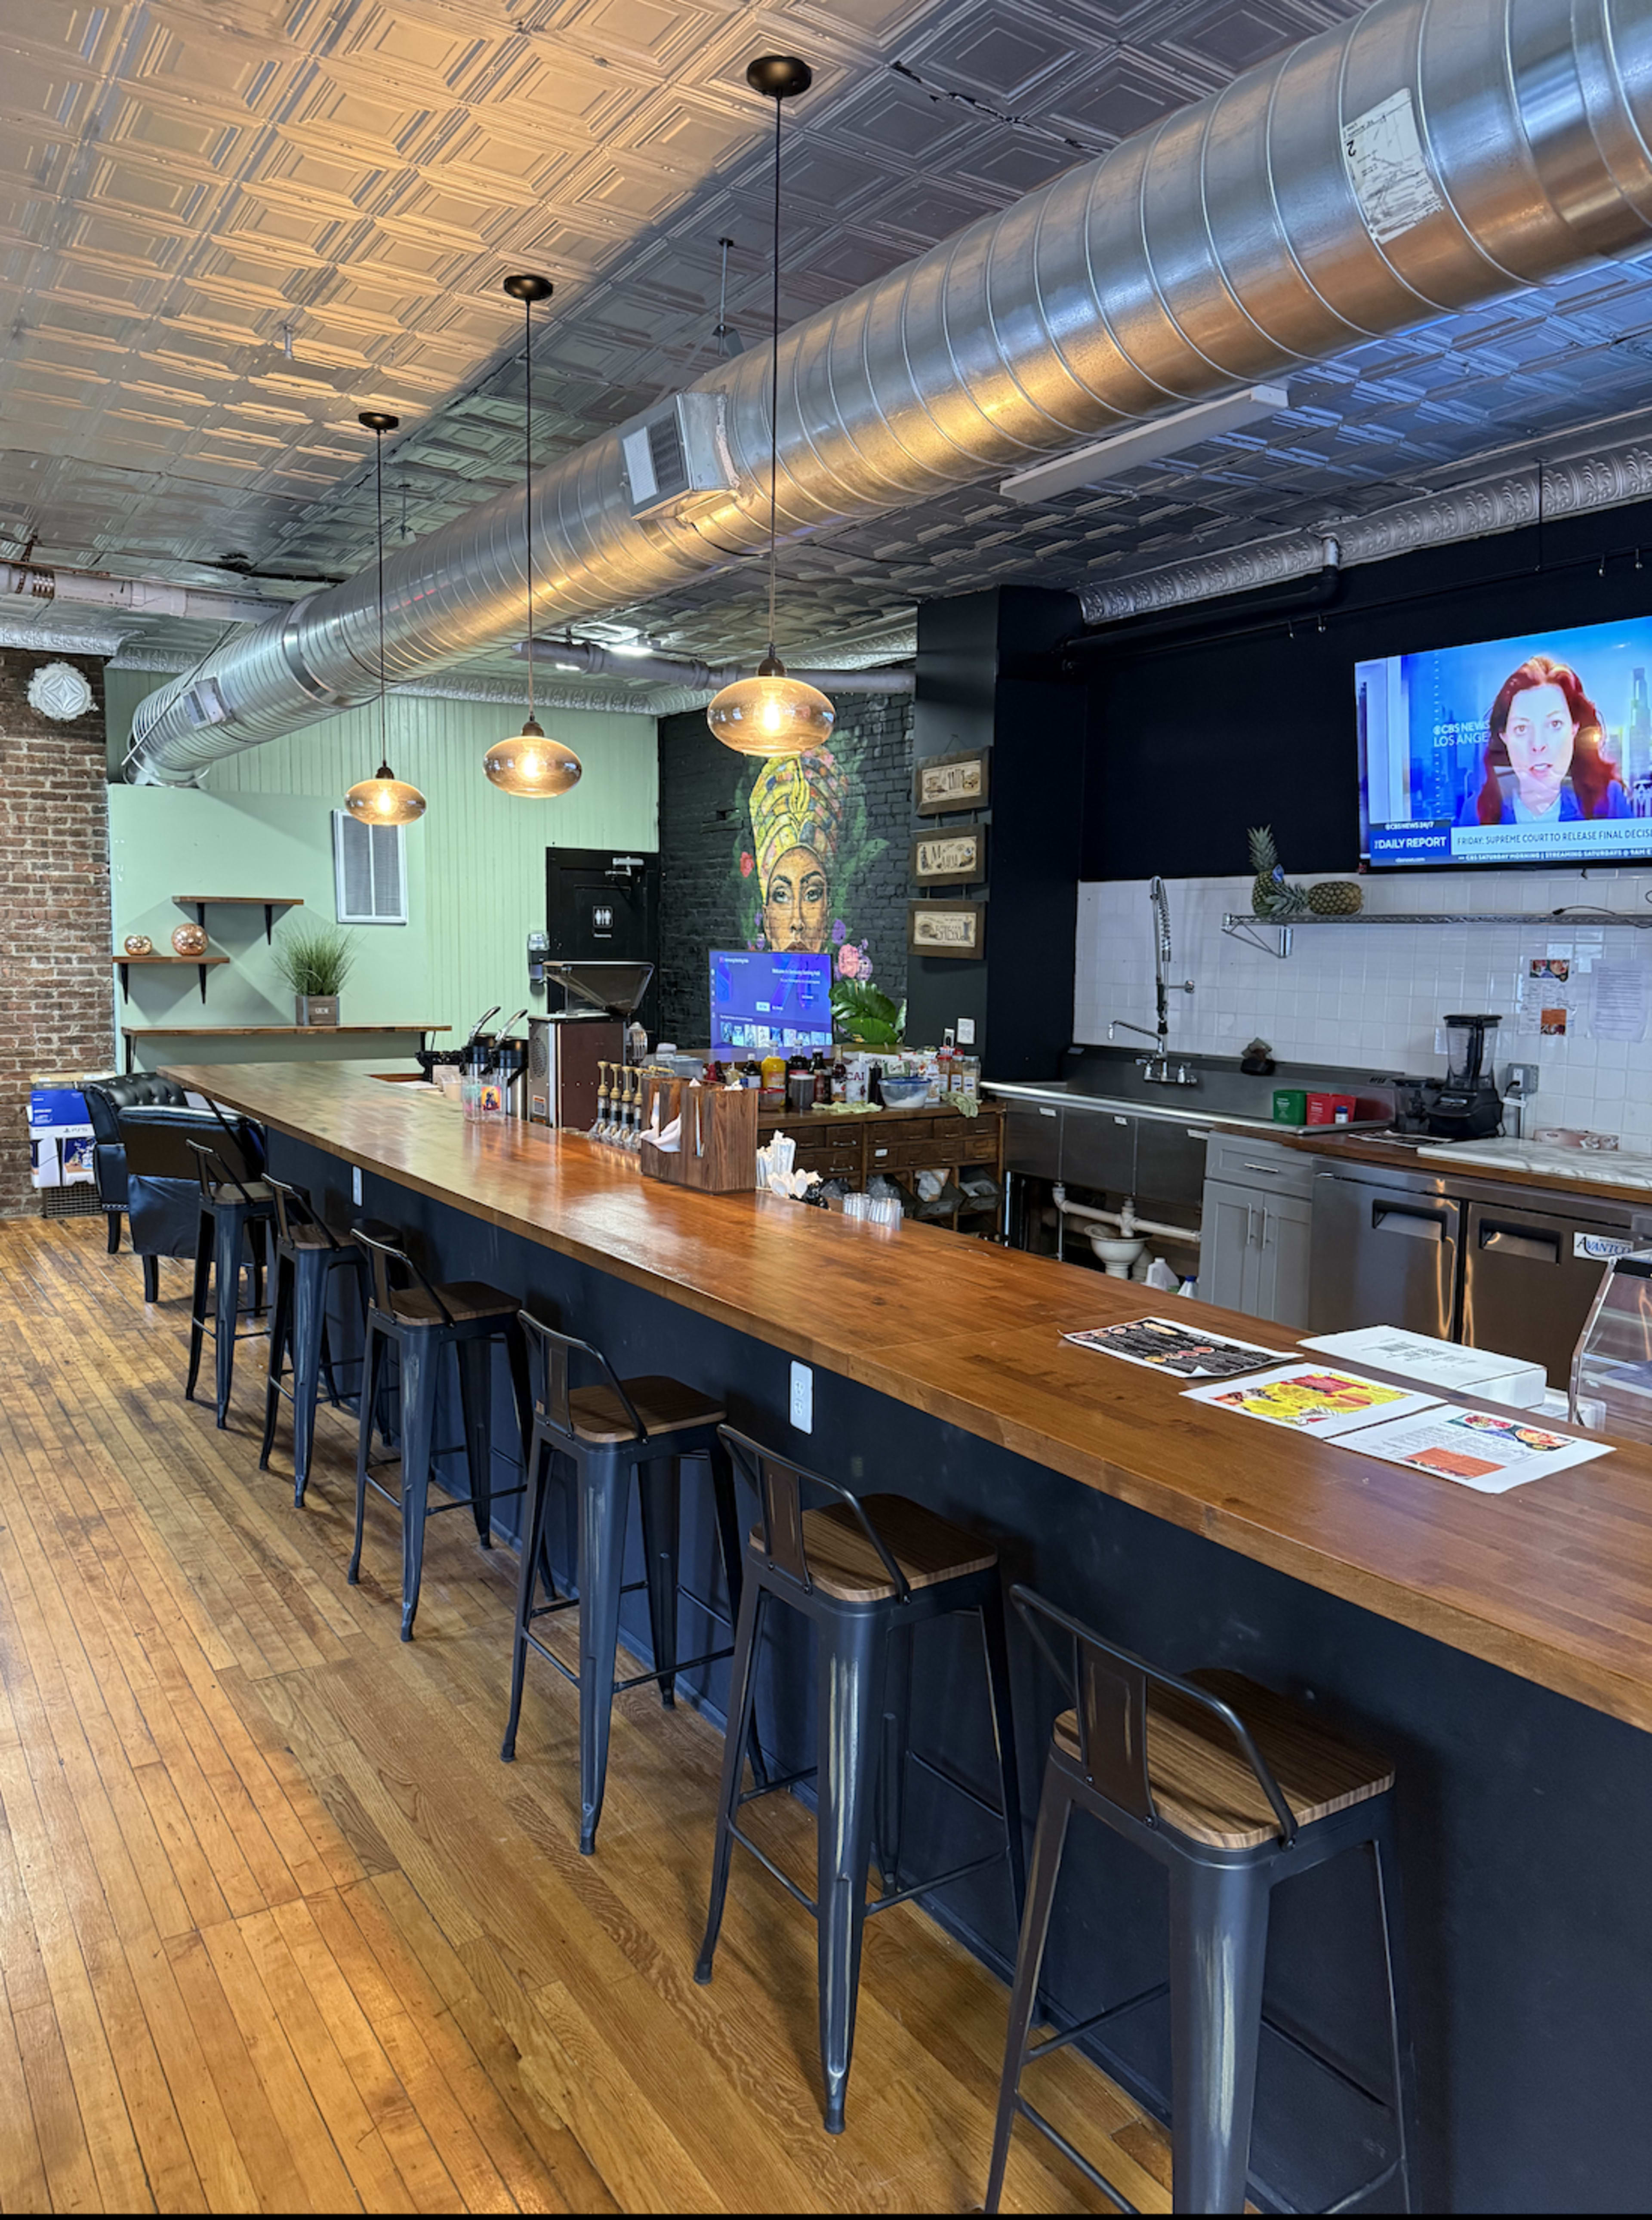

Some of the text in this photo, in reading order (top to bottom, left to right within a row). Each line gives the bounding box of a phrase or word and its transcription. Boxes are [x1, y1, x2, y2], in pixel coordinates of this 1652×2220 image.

[1441, 721, 1490, 734] CBS NEWS
[1434, 732, 1491, 747] LOS ANGE
[1378, 839, 1405, 849] DAILY
[1406, 836, 1447, 848] REPORT
[1486, 835, 1520, 844] SUPREME
[1523, 833, 1549, 843] COURT
[1550, 833, 1561, 841] TO
[1563, 831, 1597, 841] RELEASE
[1600, 829, 1623, 839] FINAL
[846, 1072, 864, 1081] CAI
[1576, 1236, 1632, 1256] AVANTCO
